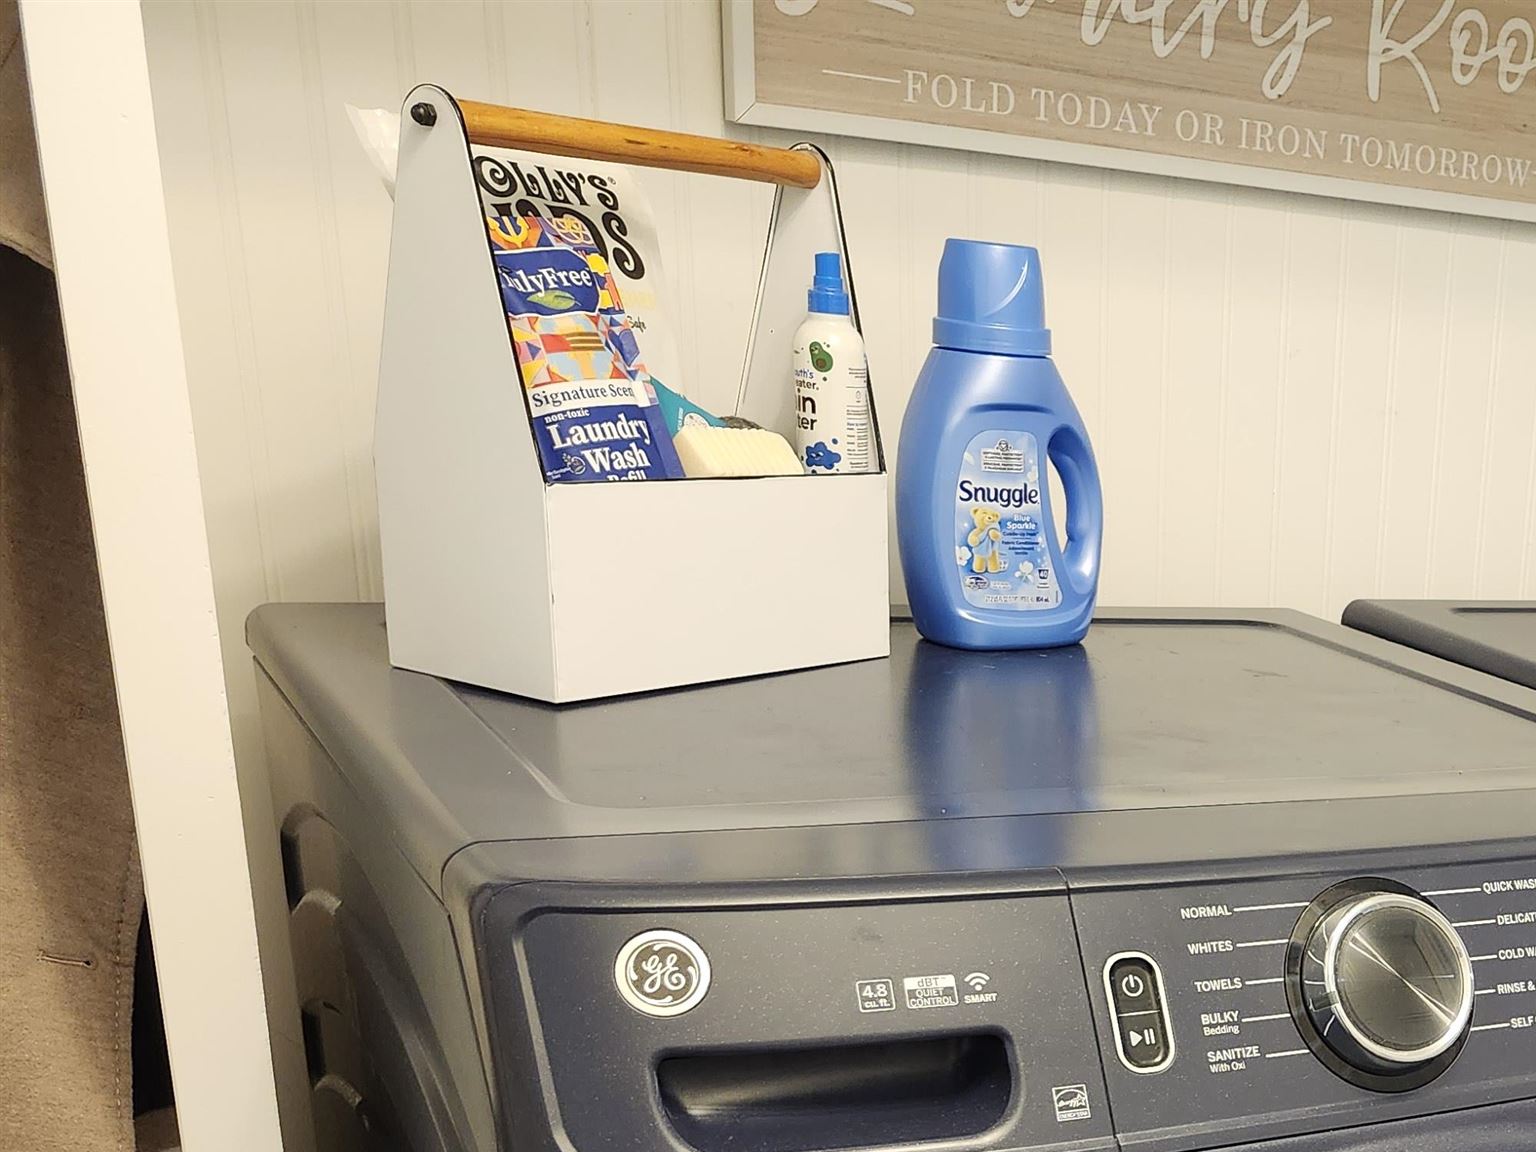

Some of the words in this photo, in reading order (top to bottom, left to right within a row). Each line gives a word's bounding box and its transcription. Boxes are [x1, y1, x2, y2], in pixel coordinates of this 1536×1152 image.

[903, 69, 1015, 115] FOLD
[1031, 88, 1162, 136] TODAY
[1175, 110, 1225, 146] OR
[1238, 118, 1327, 160] IRON
[1340, 133, 1532, 188] TOMORROW
[473, 156, 619, 211] OLLY'S
[532, 386, 607, 407] Signature
[609, 383, 635, 398] Scen
[544, 407, 591, 424] non-toxic
[546, 412, 651, 449] Laundry
[580, 442, 651, 474] Wash
[959, 480, 1039, 508] Snuggle
[1482, 880, 1514, 895] QUICK
[1180, 904, 1232, 919] NORMAL
[1187, 940, 1234, 955] WHITES
[1498, 947, 1525, 960] COLD
[862, 983, 888, 998] 4.8
[915, 988, 944, 997] QUIET
[1194, 977, 1243, 993] TOWELS
[1497, 982, 1527, 995] RINSE
[1527, 981, 1536, 992] &
[909, 996, 956, 1008] CONTROL
[964, 993, 997, 1004] SMART
[1200, 1010, 1239, 1025] BULKY
[1510, 1016, 1534, 1029] SELF
[1203, 1023, 1240, 1036] Bedding
[1207, 1045, 1261, 1063] SANITIZE
[1209, 1063, 1231, 1073] With
[1231, 1060, 1246, 1071] Oxi
